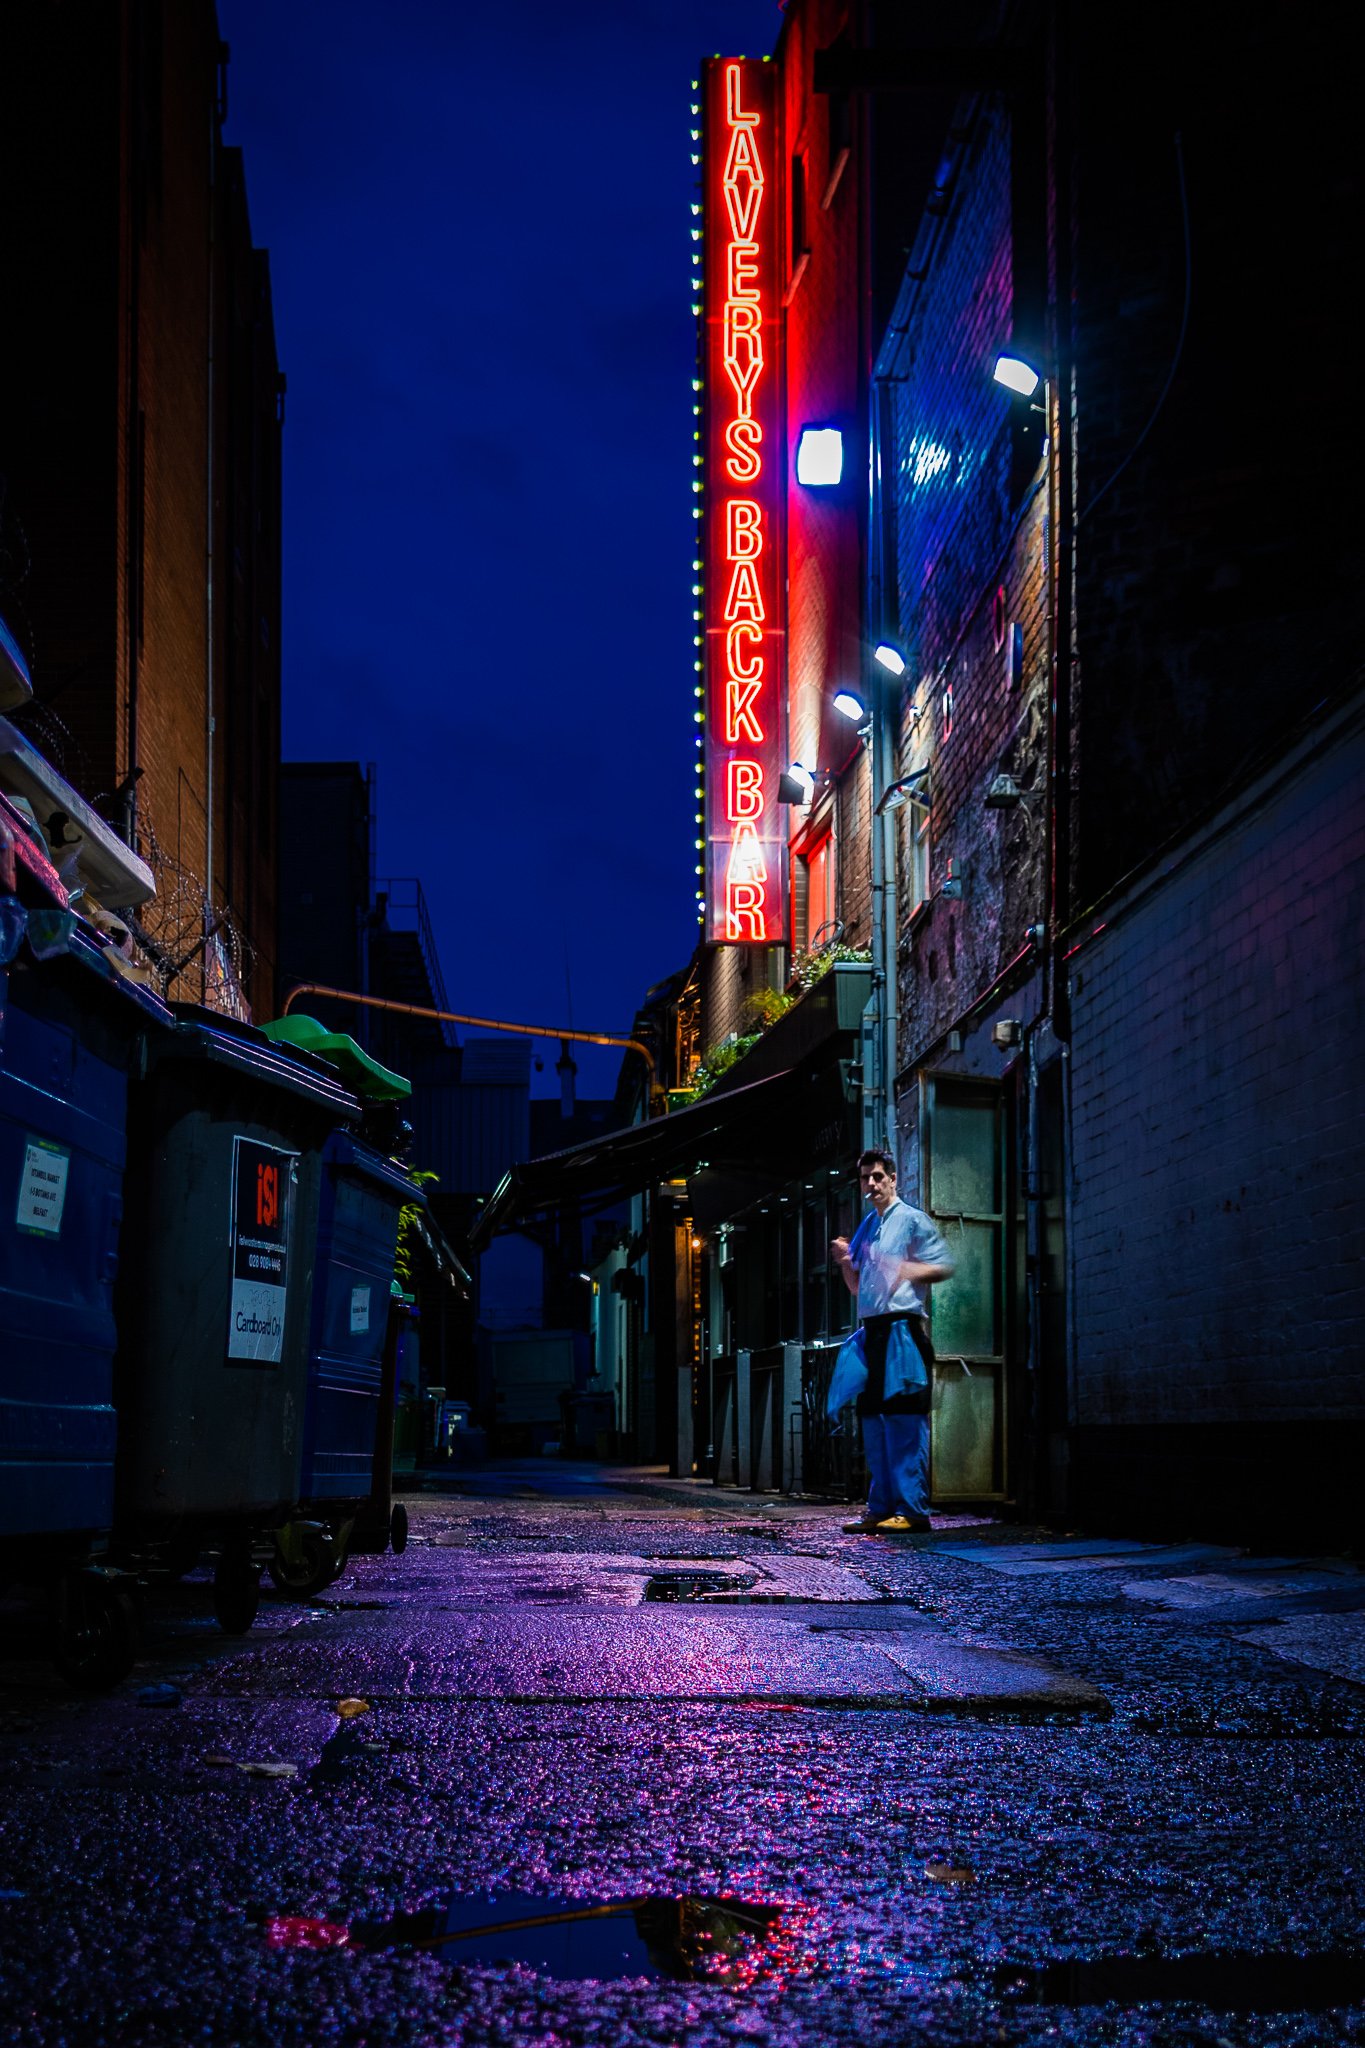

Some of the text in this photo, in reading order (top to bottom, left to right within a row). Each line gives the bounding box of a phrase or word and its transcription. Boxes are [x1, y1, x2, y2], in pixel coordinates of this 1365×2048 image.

[723, 64, 767, 942] LAVERYS BACK BAR
[248, 1254, 259, 1268] 028
[236, 1312, 271, 1335] Cardboard
